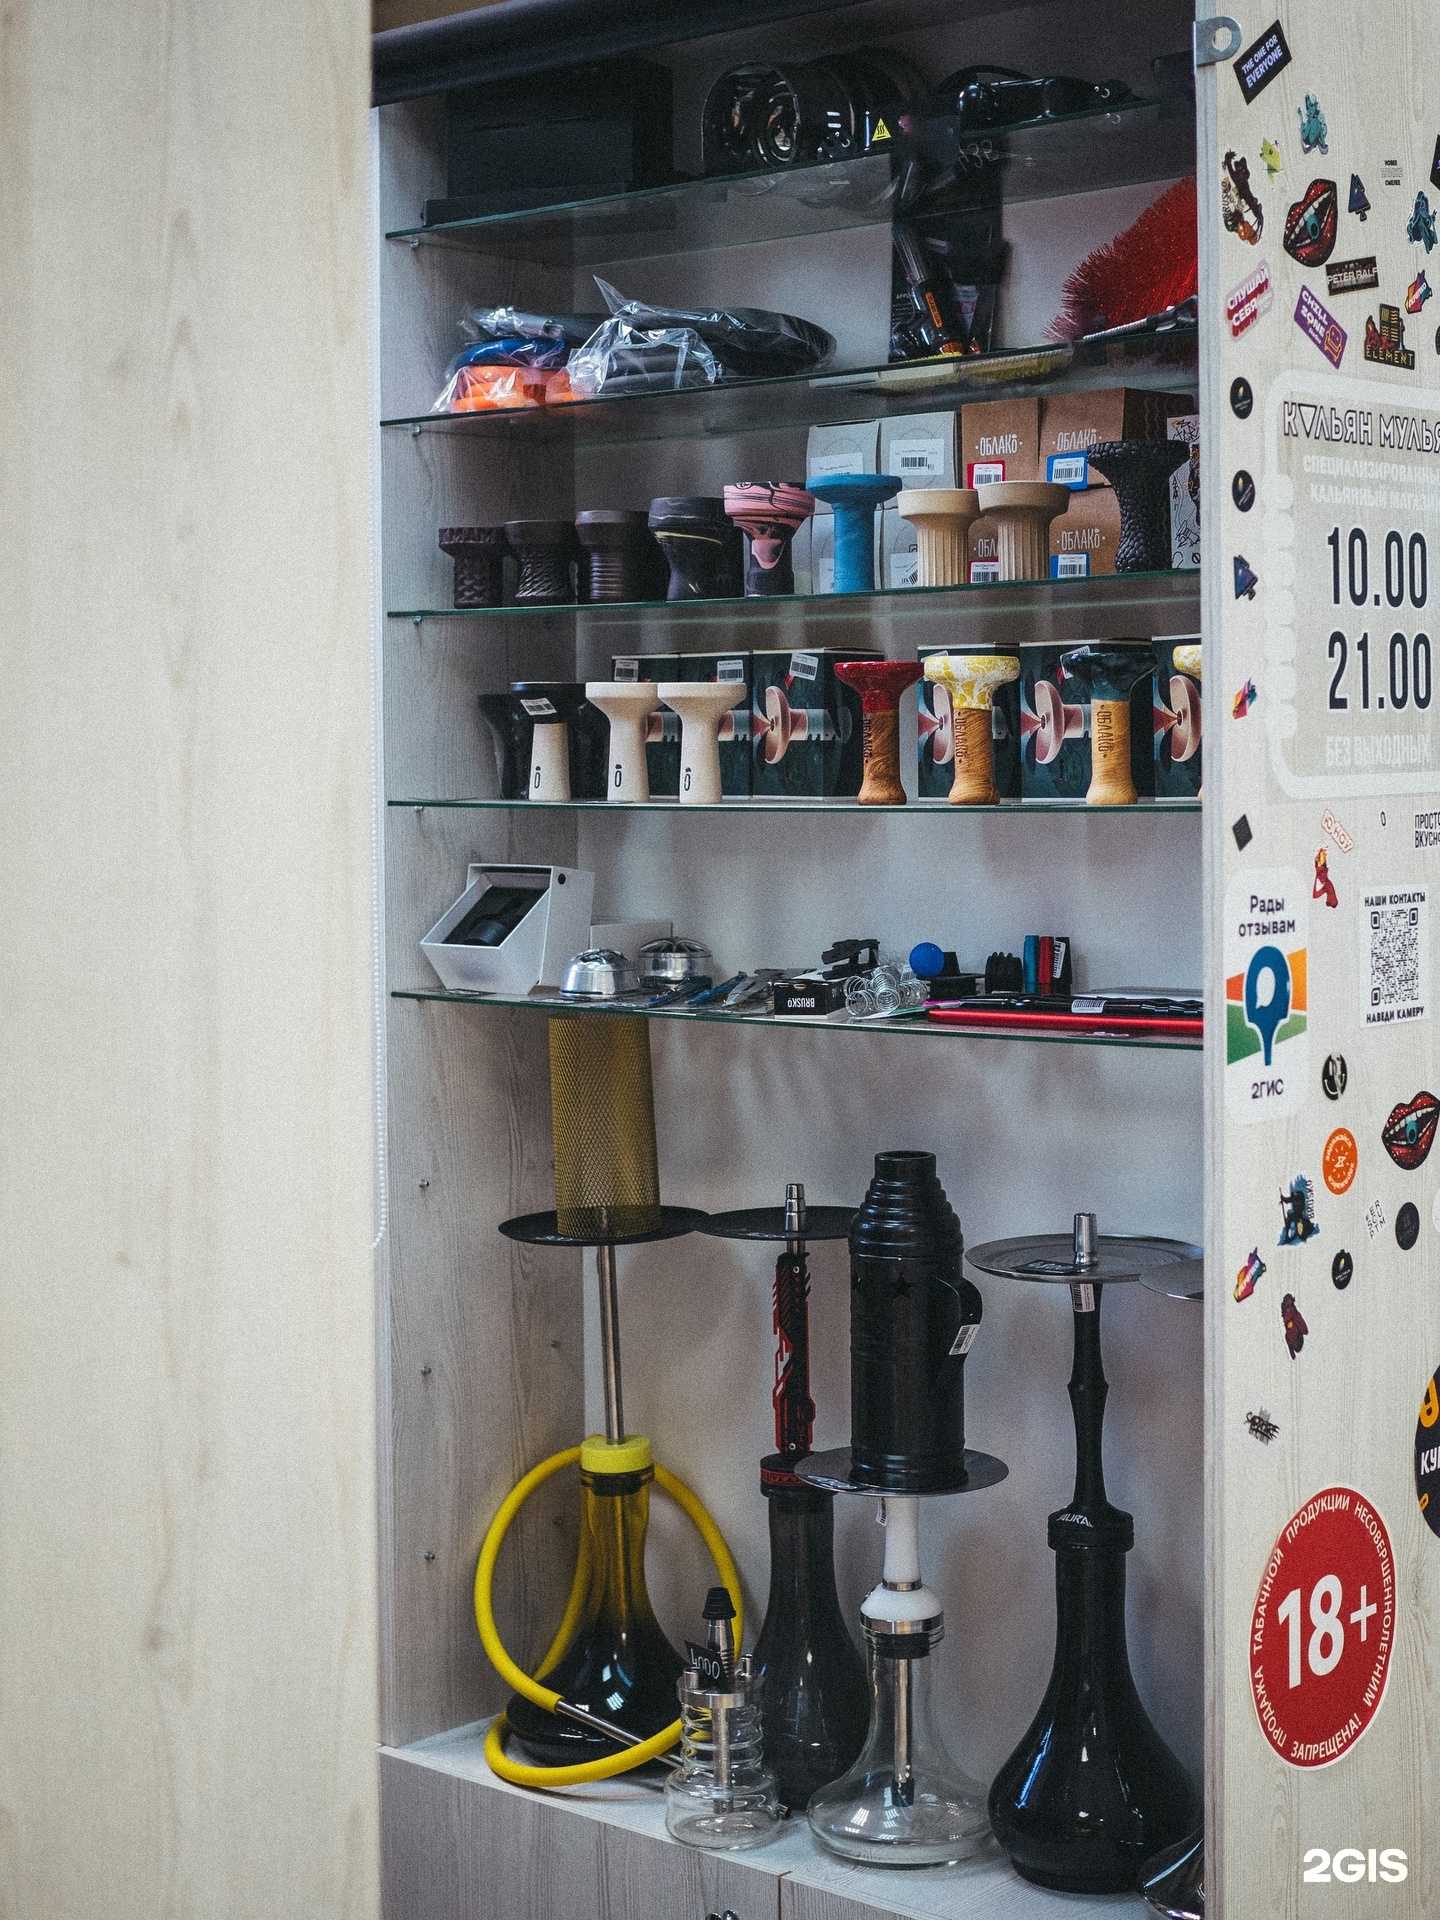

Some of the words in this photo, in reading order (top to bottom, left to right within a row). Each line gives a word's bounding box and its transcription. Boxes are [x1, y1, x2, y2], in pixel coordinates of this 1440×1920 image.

[1242, 58, 1255, 74] THE
[1253, 46, 1267, 63] ONE
[1266, 34, 1279, 50] FOR
[1246, 45, 1283, 88] EVERYONE
[1327, 271, 1356, 285] PETER
[1301, 290, 1328, 325] CHILL
[1301, 305, 1326, 338] ZONE
[1366, 344, 1414, 367] ELEMENT
[1327, 526, 1427, 609] 10.00
[1328, 631, 1432, 710] 21.00
[1250, 895, 1285, 915] Рады
[1364, 896, 1387, 907] НАШИ
[1389, 892, 1426, 905] КОНТАКТЫ
[1238, 919, 1295, 937] отзывам
[787, 997, 815, 1008] BRUSKO
[1366, 1010, 1394, 1023] НАВЕДИ
[1396, 1006, 1424, 1020] КАМЕРУ
[1251, 1078, 1284, 1099] 2ГИС
[1286, 1494, 1350, 1543] ПРОДУКЦИИ
[1253, 1547, 1284, 1655] ТАБАЧНОЙ
[1354, 1502, 1393, 1708] НЕСОВЕРШЕННОЛЕТНИМ
[1278, 1574, 1377, 1689] 18+
[1254, 1665, 1287, 1748] ПРОДАЖА
[1290, 1713, 1362, 1760] ЗАПРЕЩЕНА!
